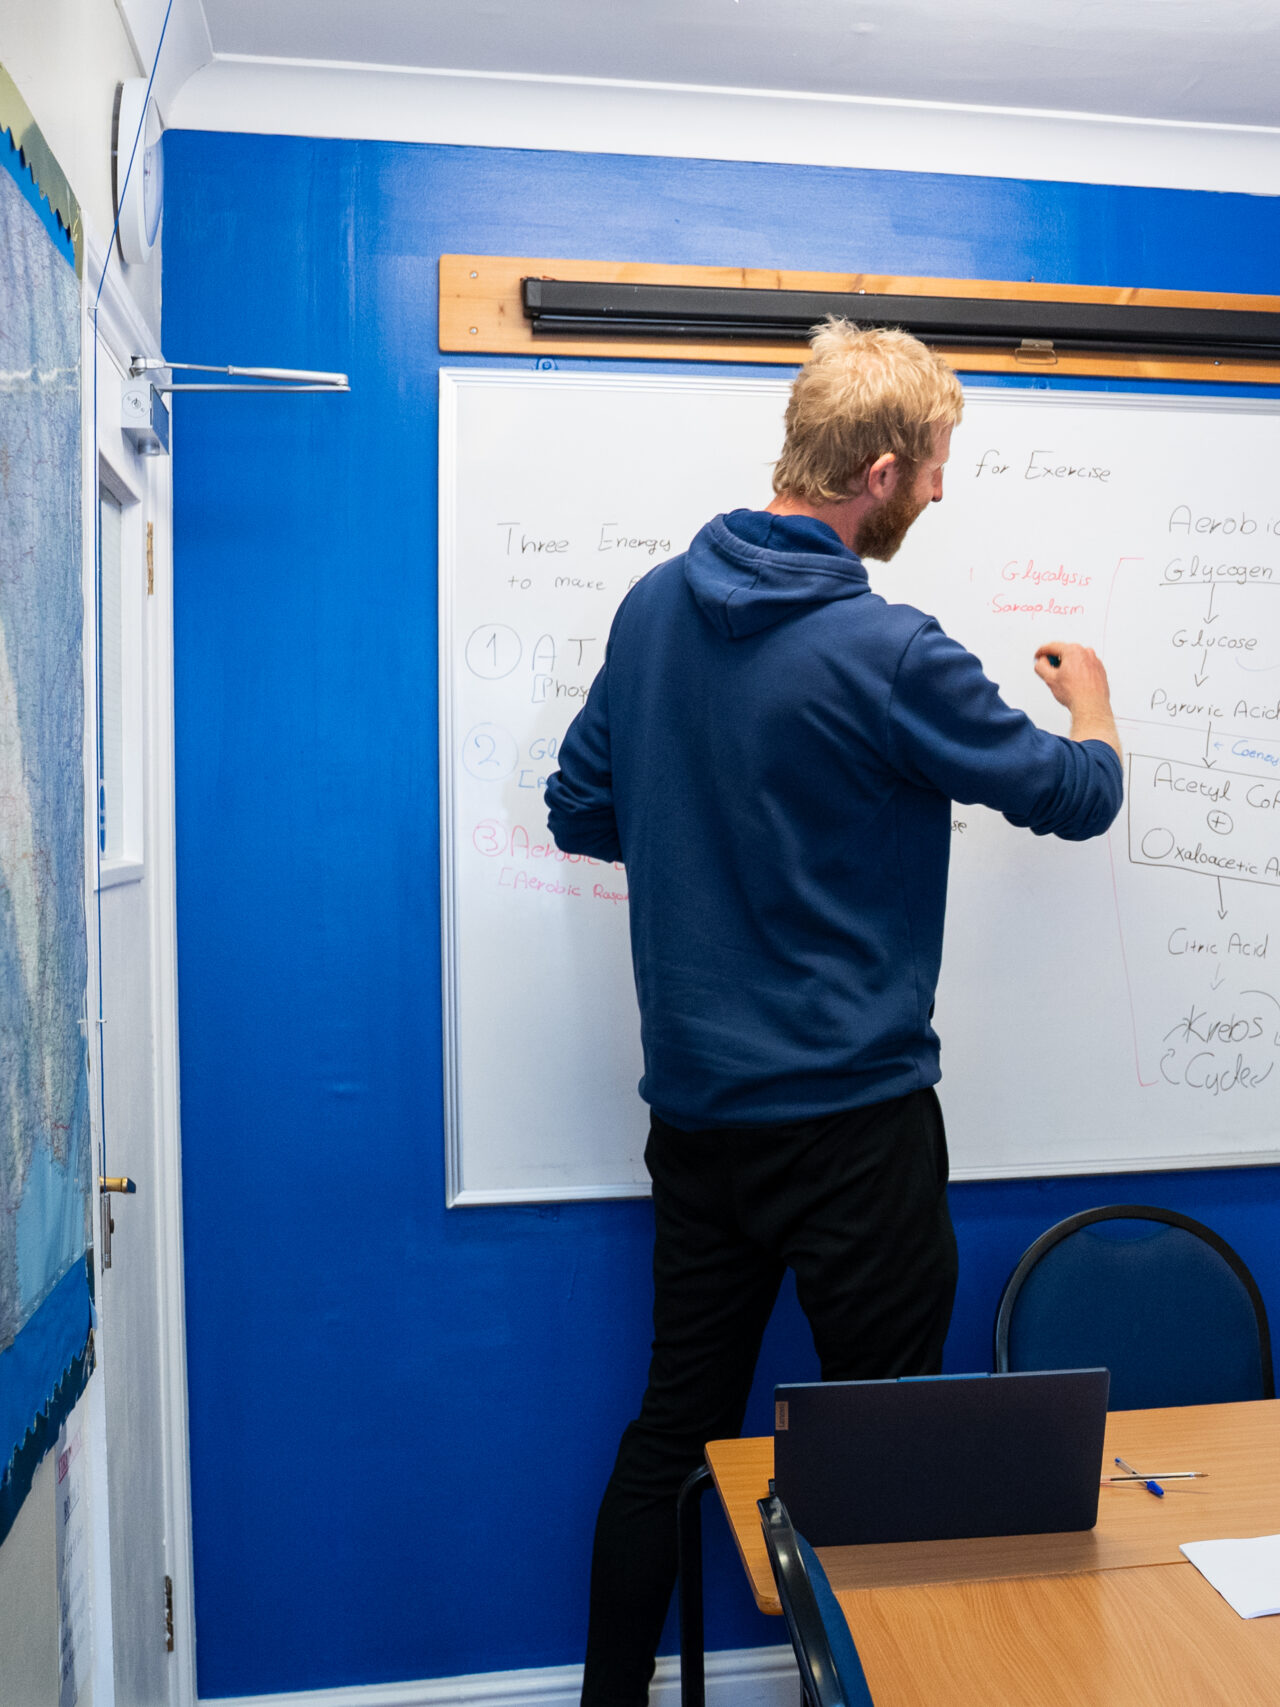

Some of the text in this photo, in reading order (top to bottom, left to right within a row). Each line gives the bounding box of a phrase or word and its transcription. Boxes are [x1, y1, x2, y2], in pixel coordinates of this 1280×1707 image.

[974, 449, 1112, 483] for Exercise
[497, 522, 671, 556] Three Energy
[508, 575, 607, 591] to make
[1164, 555, 1274, 585] Glycogen
[1171, 629, 1259, 652] Glucose
[1153, 762, 1231, 803] Acetyl
[1141, 828, 1258, 876] Oxaloacetic
[1168, 927, 1269, 959] Citric Acid
